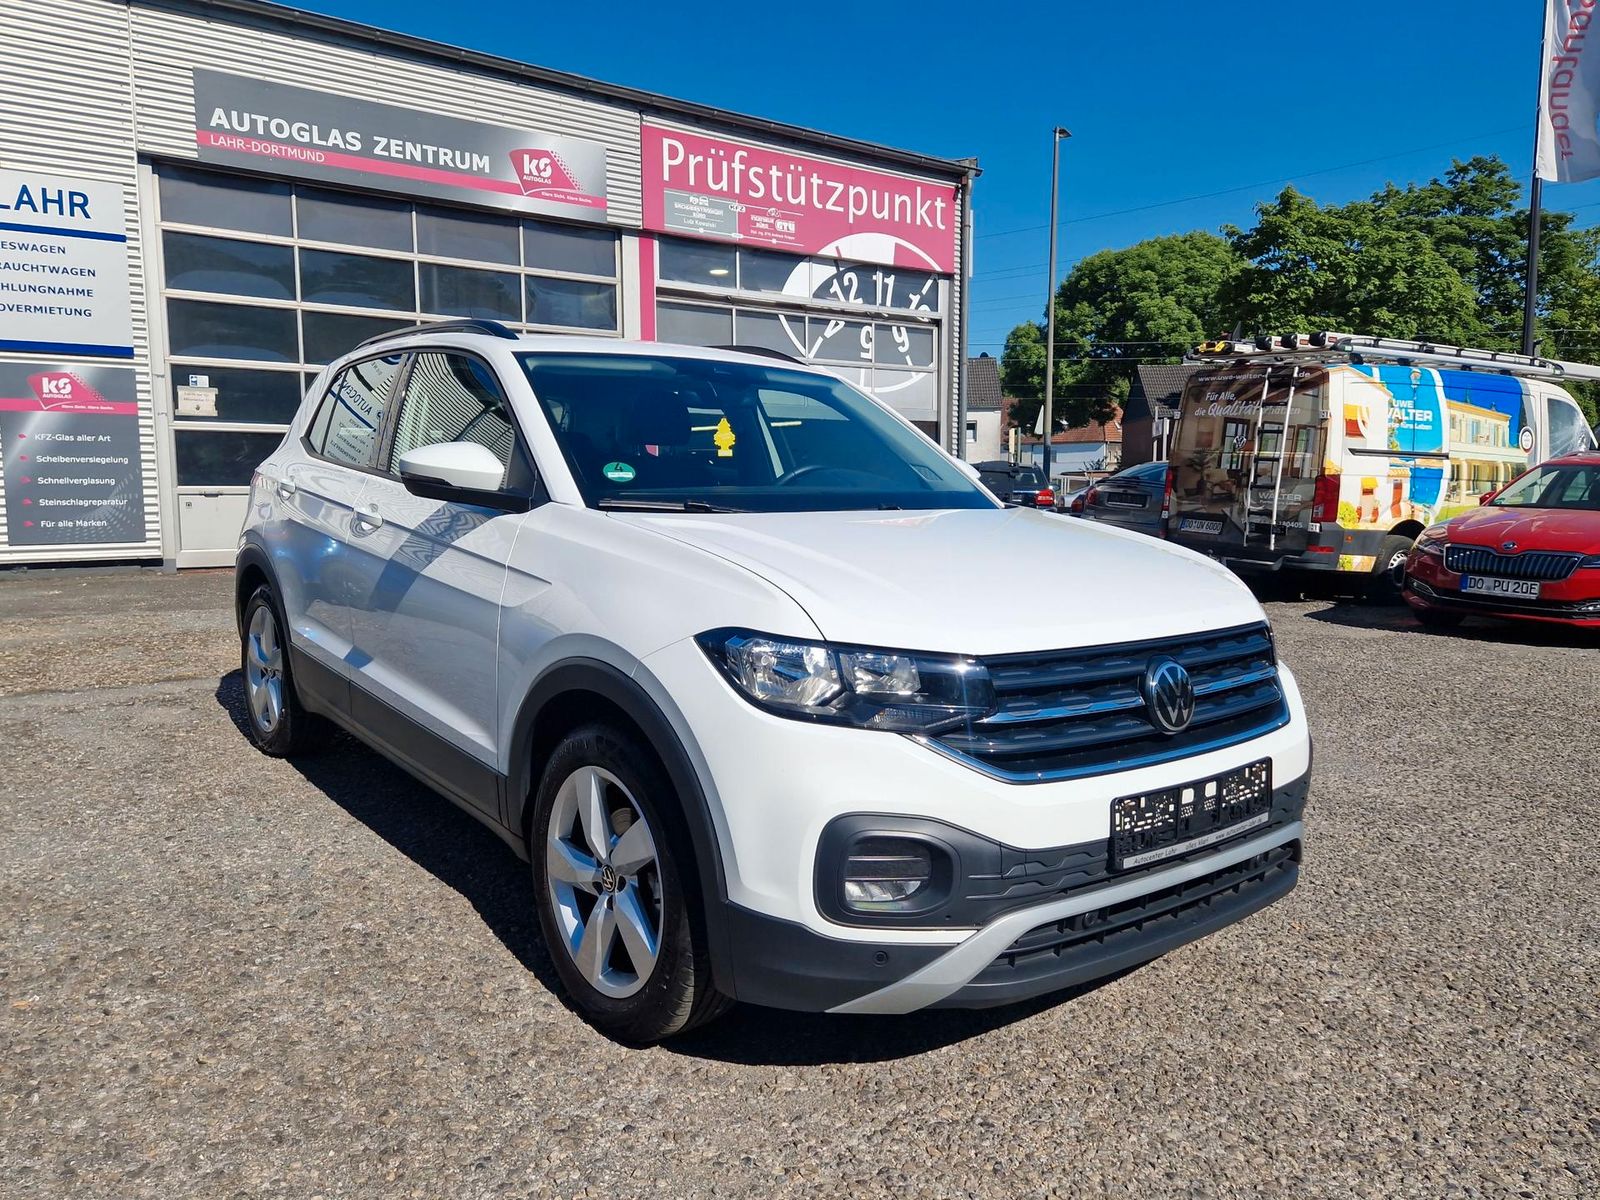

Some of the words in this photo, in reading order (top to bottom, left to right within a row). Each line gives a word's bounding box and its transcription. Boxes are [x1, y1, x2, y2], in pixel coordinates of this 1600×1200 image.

[209, 107, 362, 151] AUTOGLAS
[373, 135, 490, 173] ZENTRUM
[210, 134, 325, 162] LAHR-DORTMUND
[523, 174, 552, 184] AUTOGLAS
[662, 137, 946, 230] Prüfstützpunkt
[830, 271, 863, 302] 12
[1205, 392, 1218, 400] Für
[1391, 399, 1414, 408] UWE
[1194, 408, 1206, 416] die
[1207, 400, 1261, 417] Qualität
[35, 433, 74, 441] KFZ-Glas
[76, 434, 95, 442] aller
[98, 434, 111, 442] Art
[36, 455, 129, 464] Scheibenversiegelung
[614, 463, 623, 472] 4
[37, 477, 116, 486] Schnellverglasung
[39, 498, 128, 507] Steinschlagreparatur
[40, 520, 56, 528] Für
[58, 520, 73, 528] alle
[1468, 577, 1485, 590] DO
[1493, 579, 1511, 593] PU
